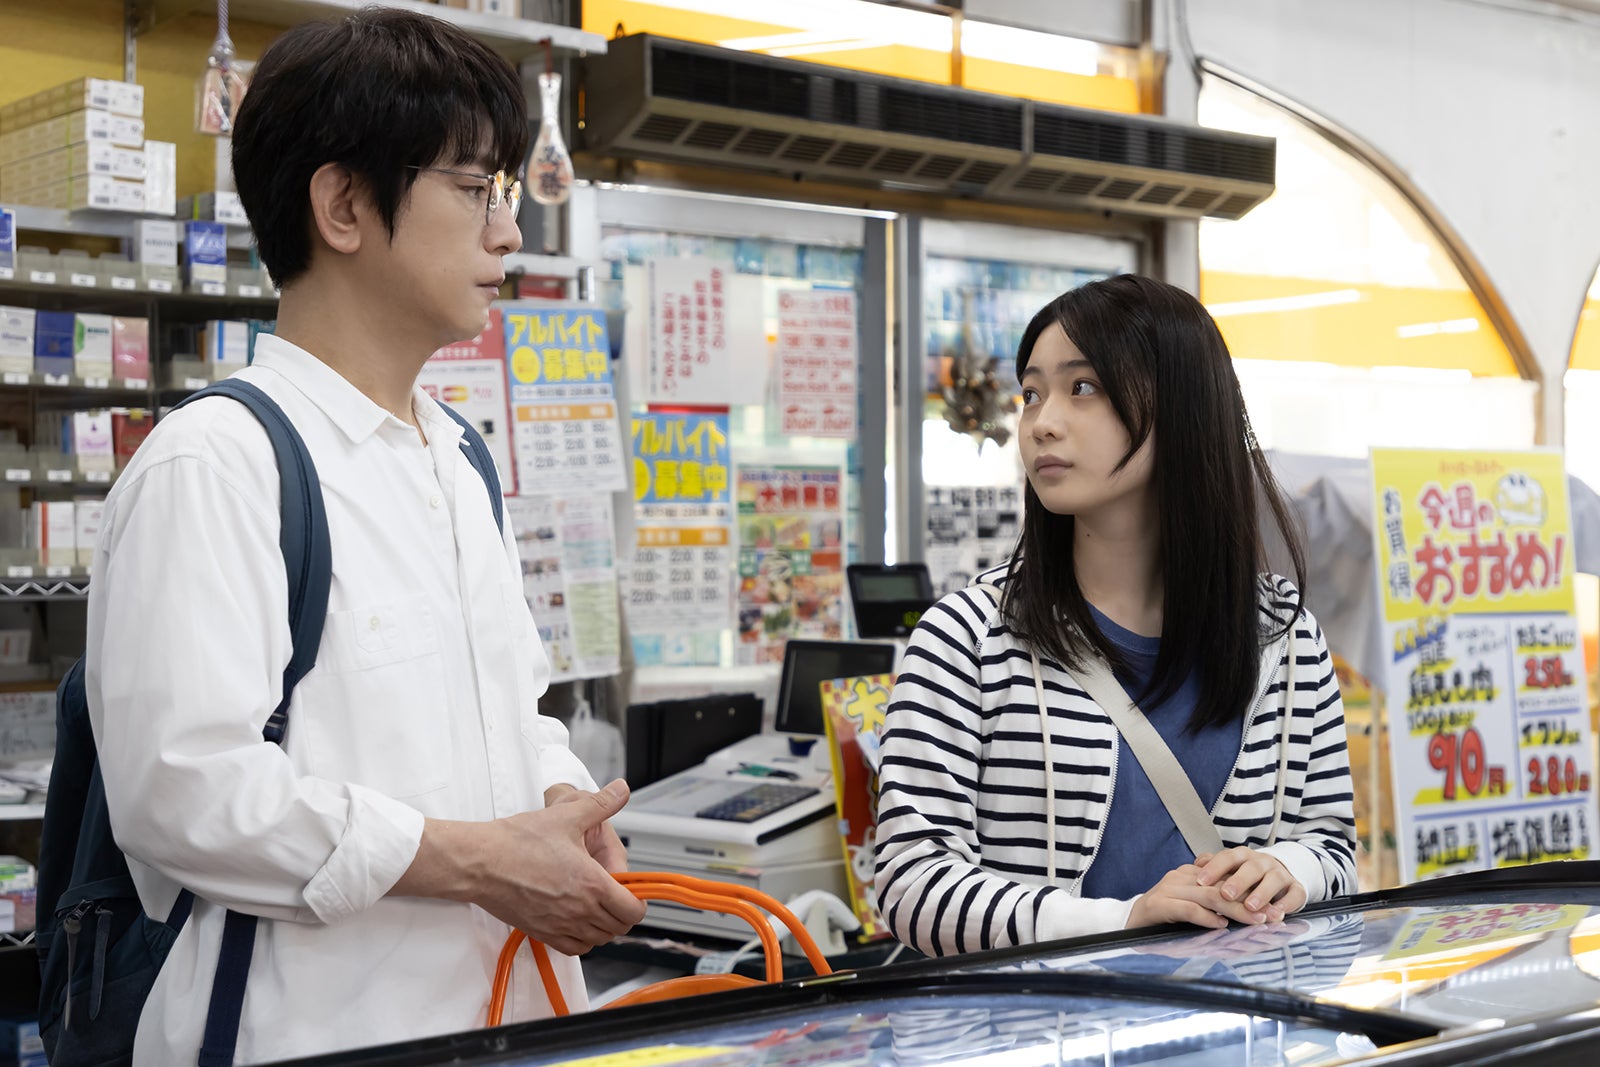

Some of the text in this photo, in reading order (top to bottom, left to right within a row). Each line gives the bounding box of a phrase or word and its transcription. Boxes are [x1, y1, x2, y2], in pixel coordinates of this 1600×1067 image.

[507, 314, 603, 345] アルバイト
[542, 348, 607, 381] 募集中
[654, 459, 728, 500] 募集中
[1420, 486, 1493, 529] 今週の
[1414, 532, 1563, 604] おすすめ!
[1428, 728, 1505, 800] 90円
